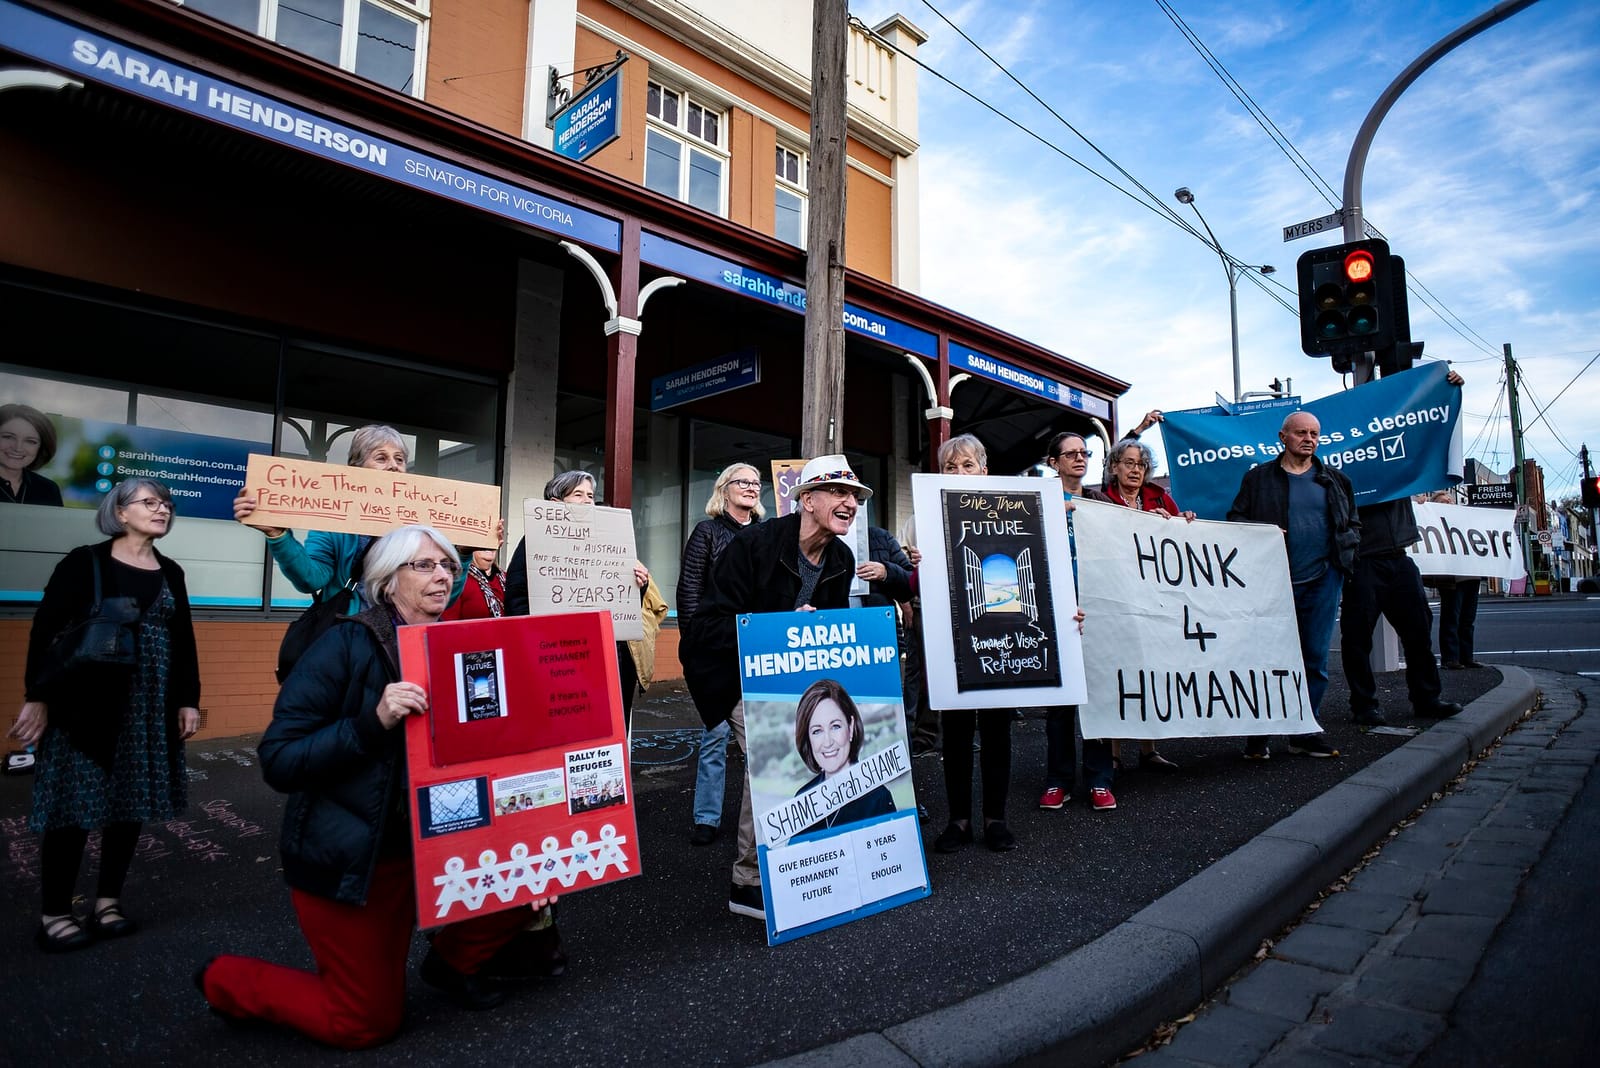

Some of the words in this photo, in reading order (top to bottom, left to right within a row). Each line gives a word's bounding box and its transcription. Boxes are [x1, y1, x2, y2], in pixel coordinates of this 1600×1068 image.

[570, 94, 600, 124] SARAH
[558, 97, 612, 146] HENDERSON
[72, 39, 198, 102] SARAH
[207, 87, 388, 167] HENDERSON
[404, 158, 477, 195] SENATOR
[480, 184, 510, 206] FOR
[512, 195, 574, 228] VICTORIA
[1285, 219, 1323, 239] MYERS
[665, 373, 690, 390] SARAH
[691, 360, 740, 382] HENDERSON
[704, 376, 727, 388] VICTORIA
[967, 354, 997, 374] SARAH
[998, 365, 1044, 392] HENDERSON
[1273, 400, 1293, 408] Hospital
[1177, 443, 1255, 467] choose
[1350, 427, 1364, 438] &
[1367, 404, 1450, 434] decency
[118, 449, 248, 472] sarahhenderson.com.au
[116, 465, 244, 487] SenatorSarahHenderson
[267, 463, 321, 490] Give
[322, 472, 367, 494] Them
[374, 486, 385, 496] a
[392, 480, 458, 507] Future!
[1472, 492, 1513, 500] FLOWERS
[1478, 485, 1506, 493] FRESH
[256, 487, 353, 514] PERMANENT
[428, 507, 492, 531] REFUGEES!
[534, 506, 571, 522] SEEK
[959, 493, 992, 512] Give
[995, 495, 1030, 516] Them
[986, 510, 1000, 520] a
[545, 524, 590, 538] ASYLUM
[955, 520, 1036, 548] FUTURE
[533, 554, 548, 562] AND
[564, 556, 602, 566] TREATED
[584, 544, 627, 554] AUSTRALIA
[1133, 532, 1246, 588] HONK
[539, 566, 589, 580] CRIMINAL
[600, 570, 620, 580] FOR
[552, 585, 563, 604] 8
[568, 584, 632, 604] YEARS?!
[786, 622, 856, 650] SARAH
[1184, 604, 1218, 652] 4
[971, 632, 1014, 654] Permanent
[1015, 632, 1039, 649] Visas
[538, 650, 590, 664] PERMANENT
[744, 645, 871, 678] HENDERSON
[874, 646, 896, 664] MP
[980, 648, 1048, 675] Refugees!
[1000, 651, 1012, 660] for
[1118, 669, 1304, 722] HUMANITY
[568, 750, 595, 763] RALLY
[598, 750, 610, 758] for
[570, 760, 612, 774] REFUGEES
[571, 786, 598, 797] HERE
[766, 790, 824, 843] SHAME
[824, 774, 862, 811] Sarah
[860, 746, 906, 790] SHAME
[866, 840, 872, 850] 8
[874, 833, 897, 848] YEARS
[778, 860, 798, 874] GIVE
[799, 851, 838, 870] REFUGEES
[838, 849, 846, 859] A
[880, 852, 888, 862] IS
[790, 866, 840, 888] PERMANENT
[871, 864, 902, 882] ENOUGH
[802, 884, 832, 902] FUTURE
